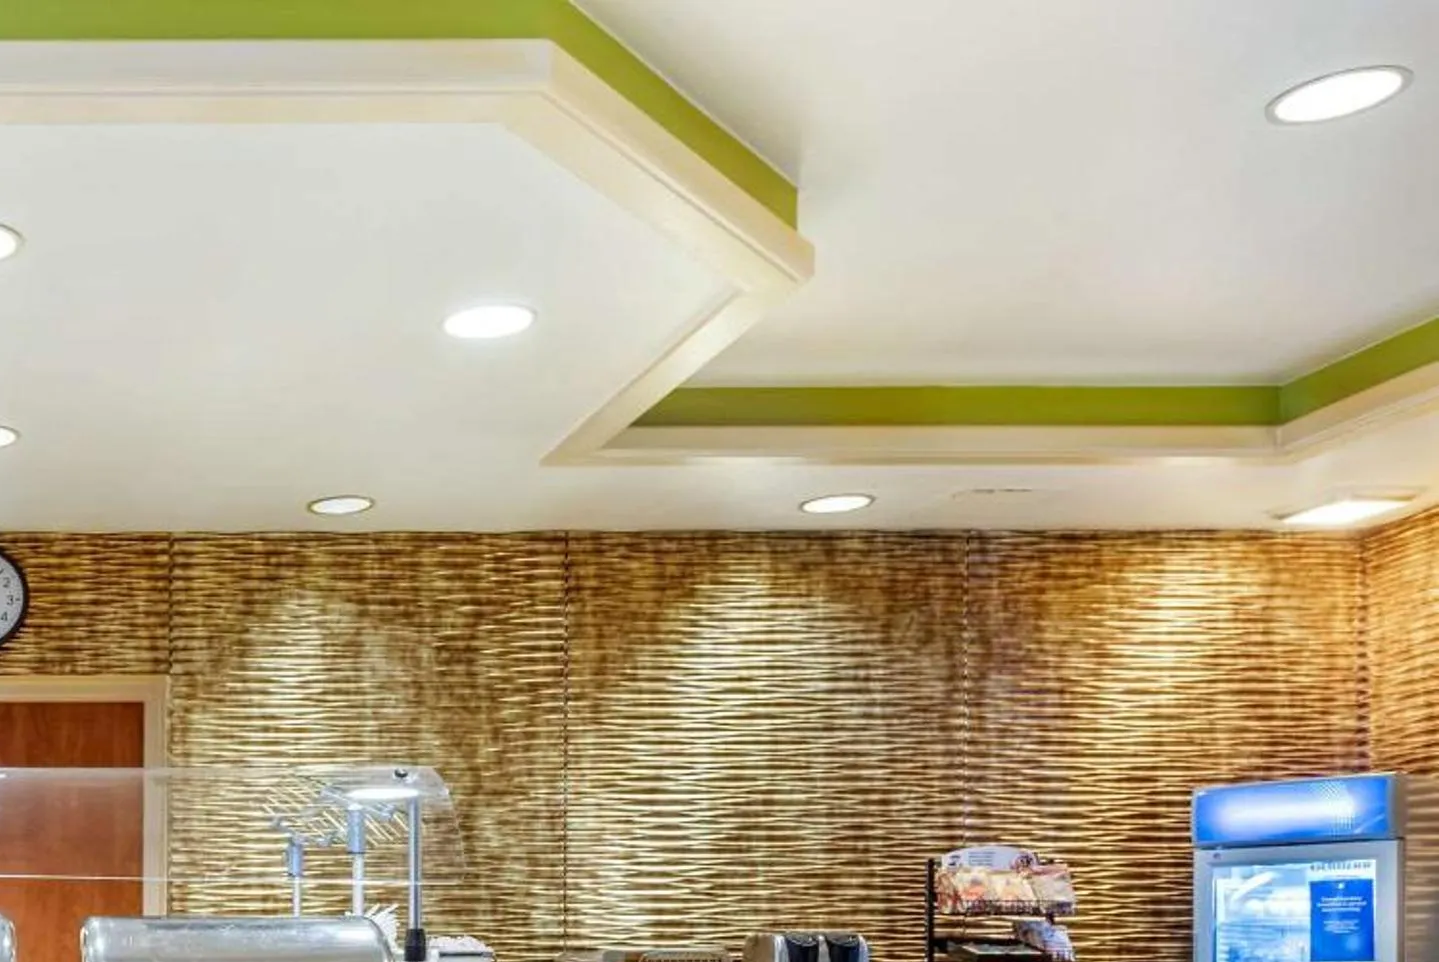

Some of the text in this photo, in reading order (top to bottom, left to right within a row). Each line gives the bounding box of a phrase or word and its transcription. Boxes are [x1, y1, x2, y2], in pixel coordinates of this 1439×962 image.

[2, 576, 11, 588] 2
[6, 594, 14, 606] 3
[0, 611, 9, 622] 4
